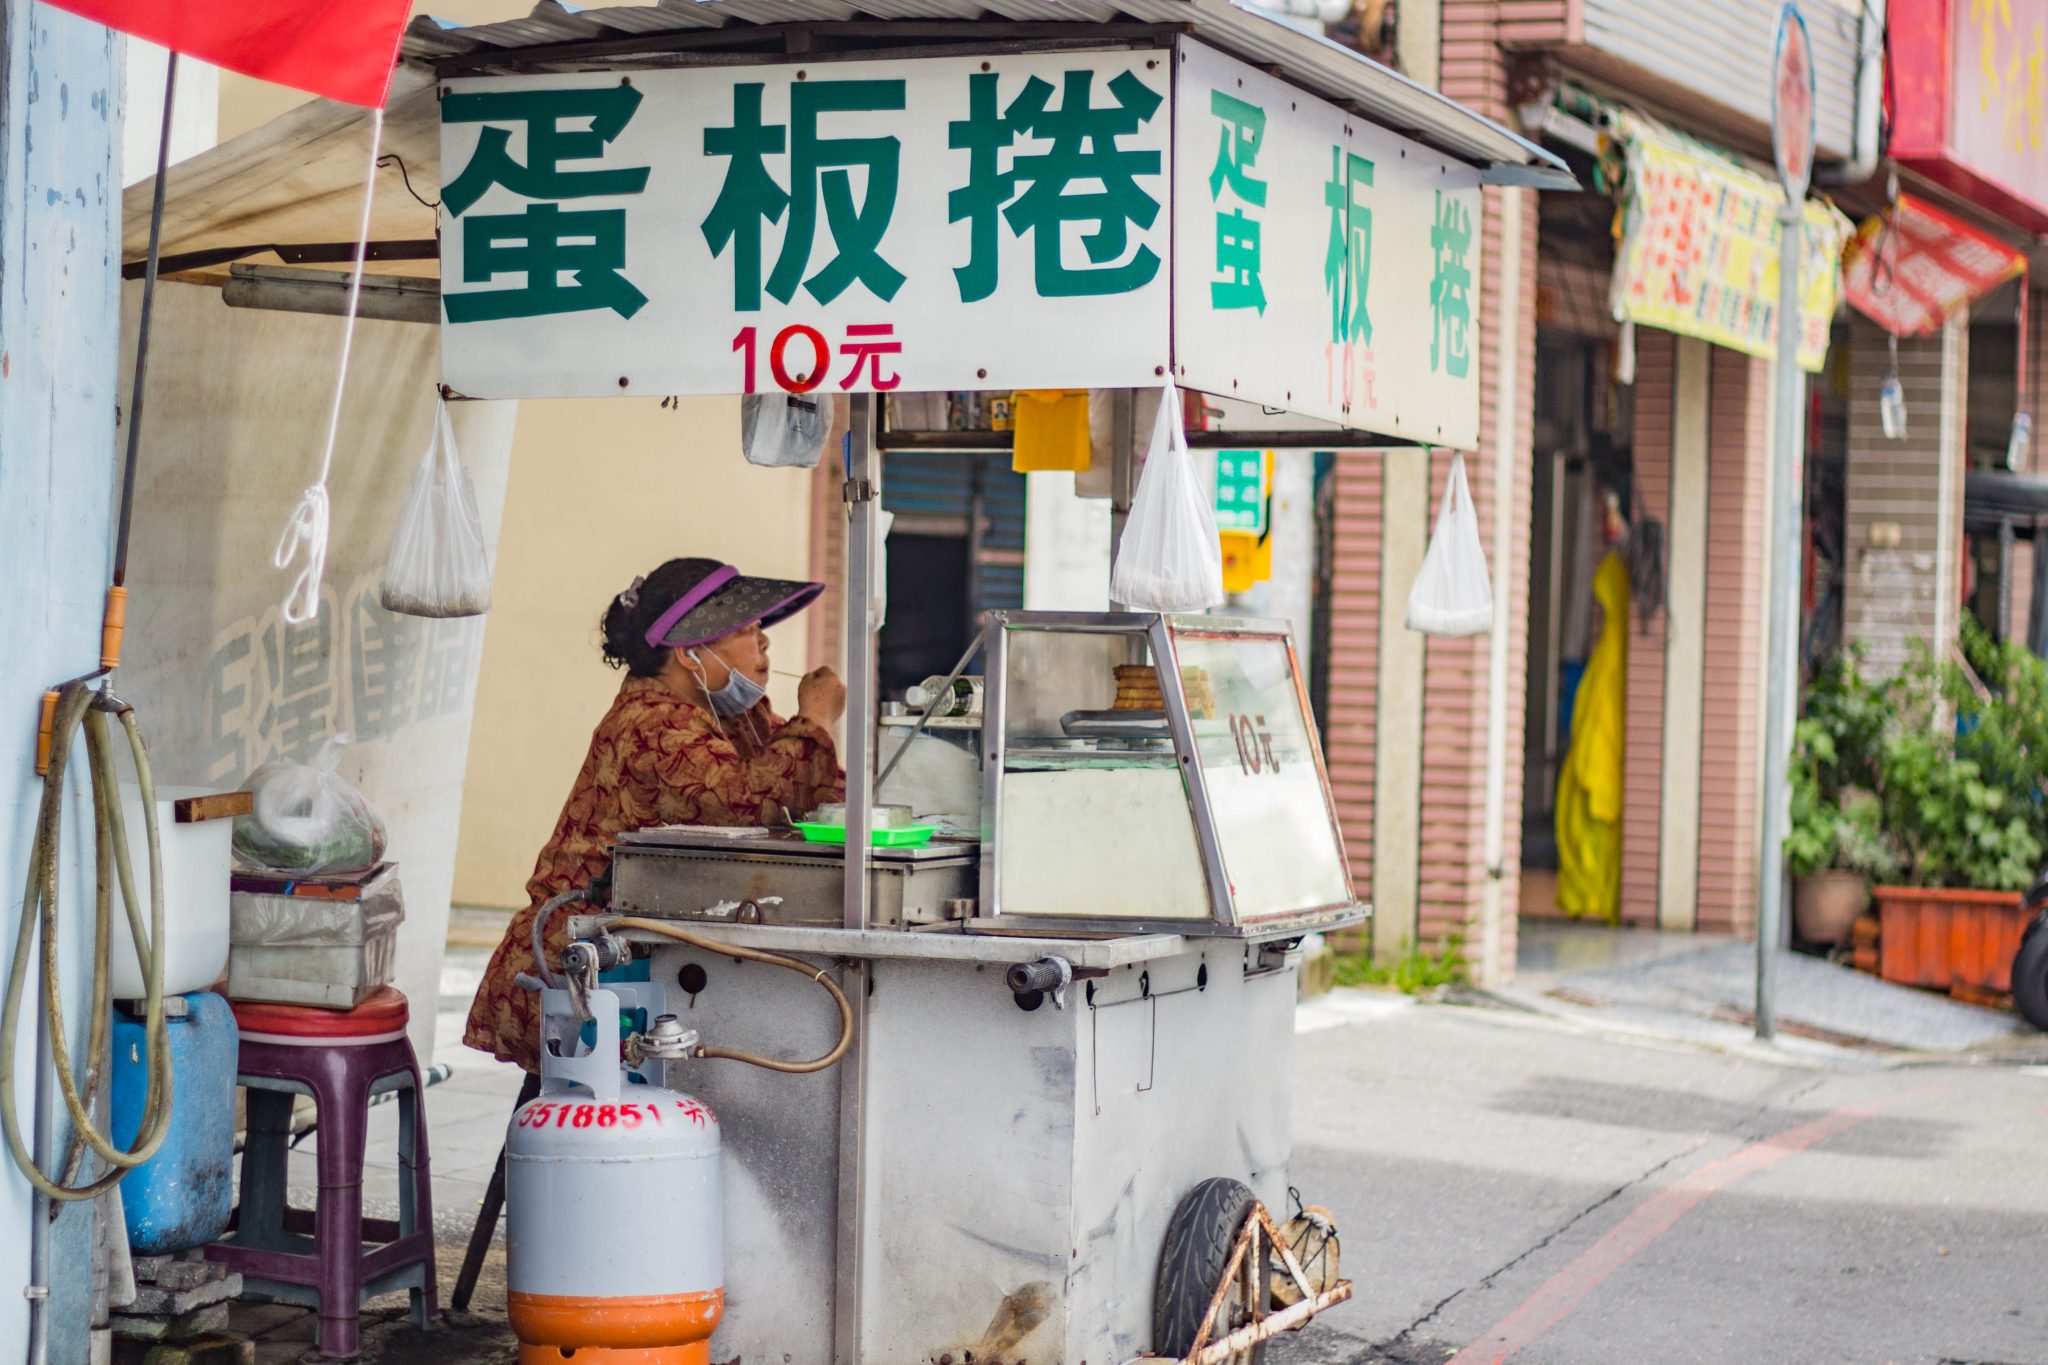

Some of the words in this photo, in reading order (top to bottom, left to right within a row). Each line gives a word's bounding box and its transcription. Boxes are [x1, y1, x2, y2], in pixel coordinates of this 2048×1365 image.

[441, 69, 1164, 324] 蛋板捲
[1209, 89, 1472, 379] 蛋板捲
[732, 324, 902, 394] 10元
[1325, 341, 1378, 410] 10元
[1229, 712, 1280, 776] 10元
[519, 1102, 664, 1130] 5518851
